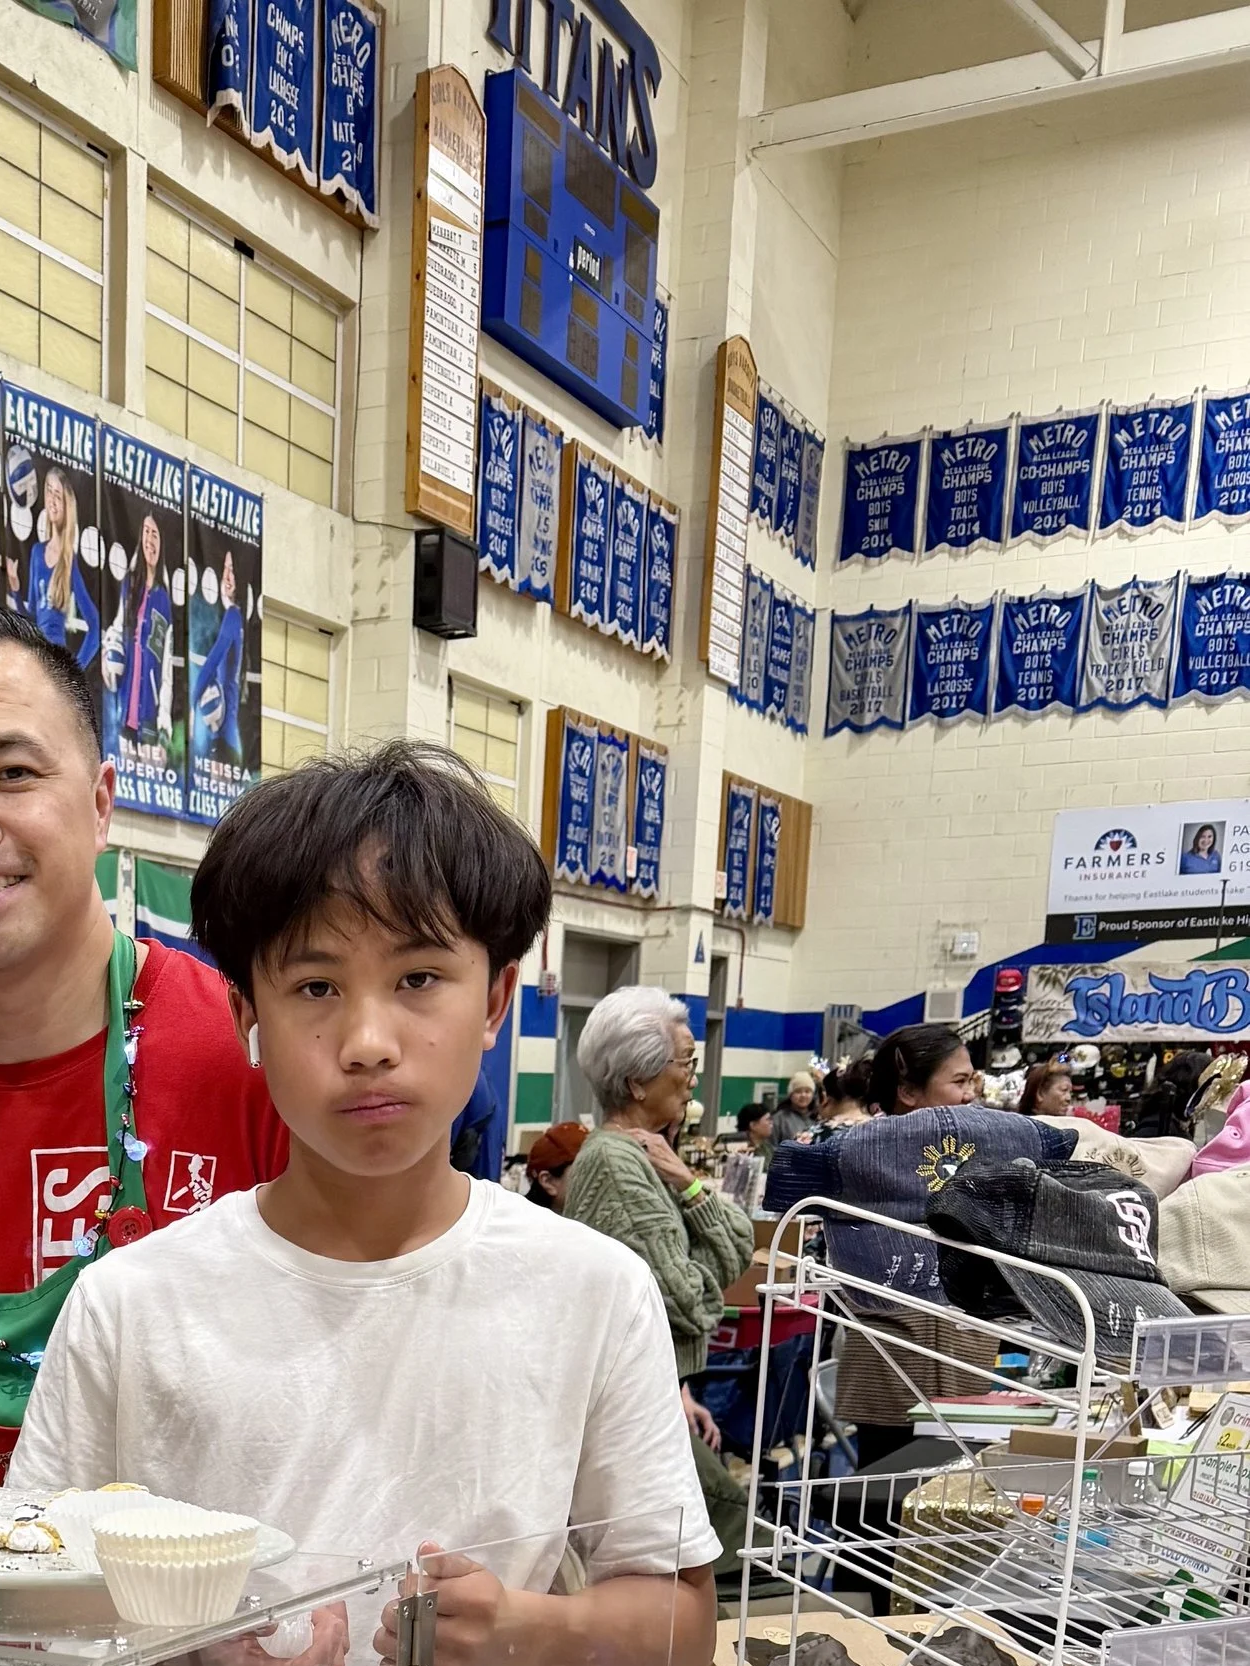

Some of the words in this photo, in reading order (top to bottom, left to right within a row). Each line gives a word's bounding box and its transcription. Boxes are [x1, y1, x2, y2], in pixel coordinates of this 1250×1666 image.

[5, 390, 94, 463] EASTLAKE
[1115, 413, 1186, 448] METRO
[1029, 424, 1087, 454] METRO
[940, 438, 998, 467] METRO
[1120, 451, 1175, 470] CHAMPS
[104, 433, 182, 502] EASTLAKE
[1020, 460, 1090, 480] CO-CHAMPS
[942, 470, 992, 489] CHAMPS
[1133, 469, 1159, 485] BOYS
[954, 489, 977, 503] BOYS
[1041, 480, 1065, 495] BOYS
[1127, 486, 1162, 502] TENNIS
[191, 474, 260, 536] EASTLAKE
[951, 505, 978, 520] TRACK
[1023, 495, 1080, 513] VOLLEYBALL
[1122, 502, 1161, 519] 2014
[947, 521, 980, 538] 2014
[1033, 514, 1066, 530] 2014
[1014, 604, 1072, 633] METRO
[926, 614, 982, 643] METRO
[1013, 638, 1066, 654] CHAMPS
[927, 647, 978, 665] CHAMPS
[1024, 654, 1051, 669] BOYS
[932, 695, 967, 710] 2017
[1017, 686, 1053, 701] 2017
[1064, 852, 1165, 870] FARMERS
[1079, 870, 1147, 881] INSURANCE
[1099, 918, 1129, 931] Proud
[1132, 918, 1174, 931] Sponsor
[1177, 918, 1189, 928] of
[1061, 970, 1206, 1037] Island
